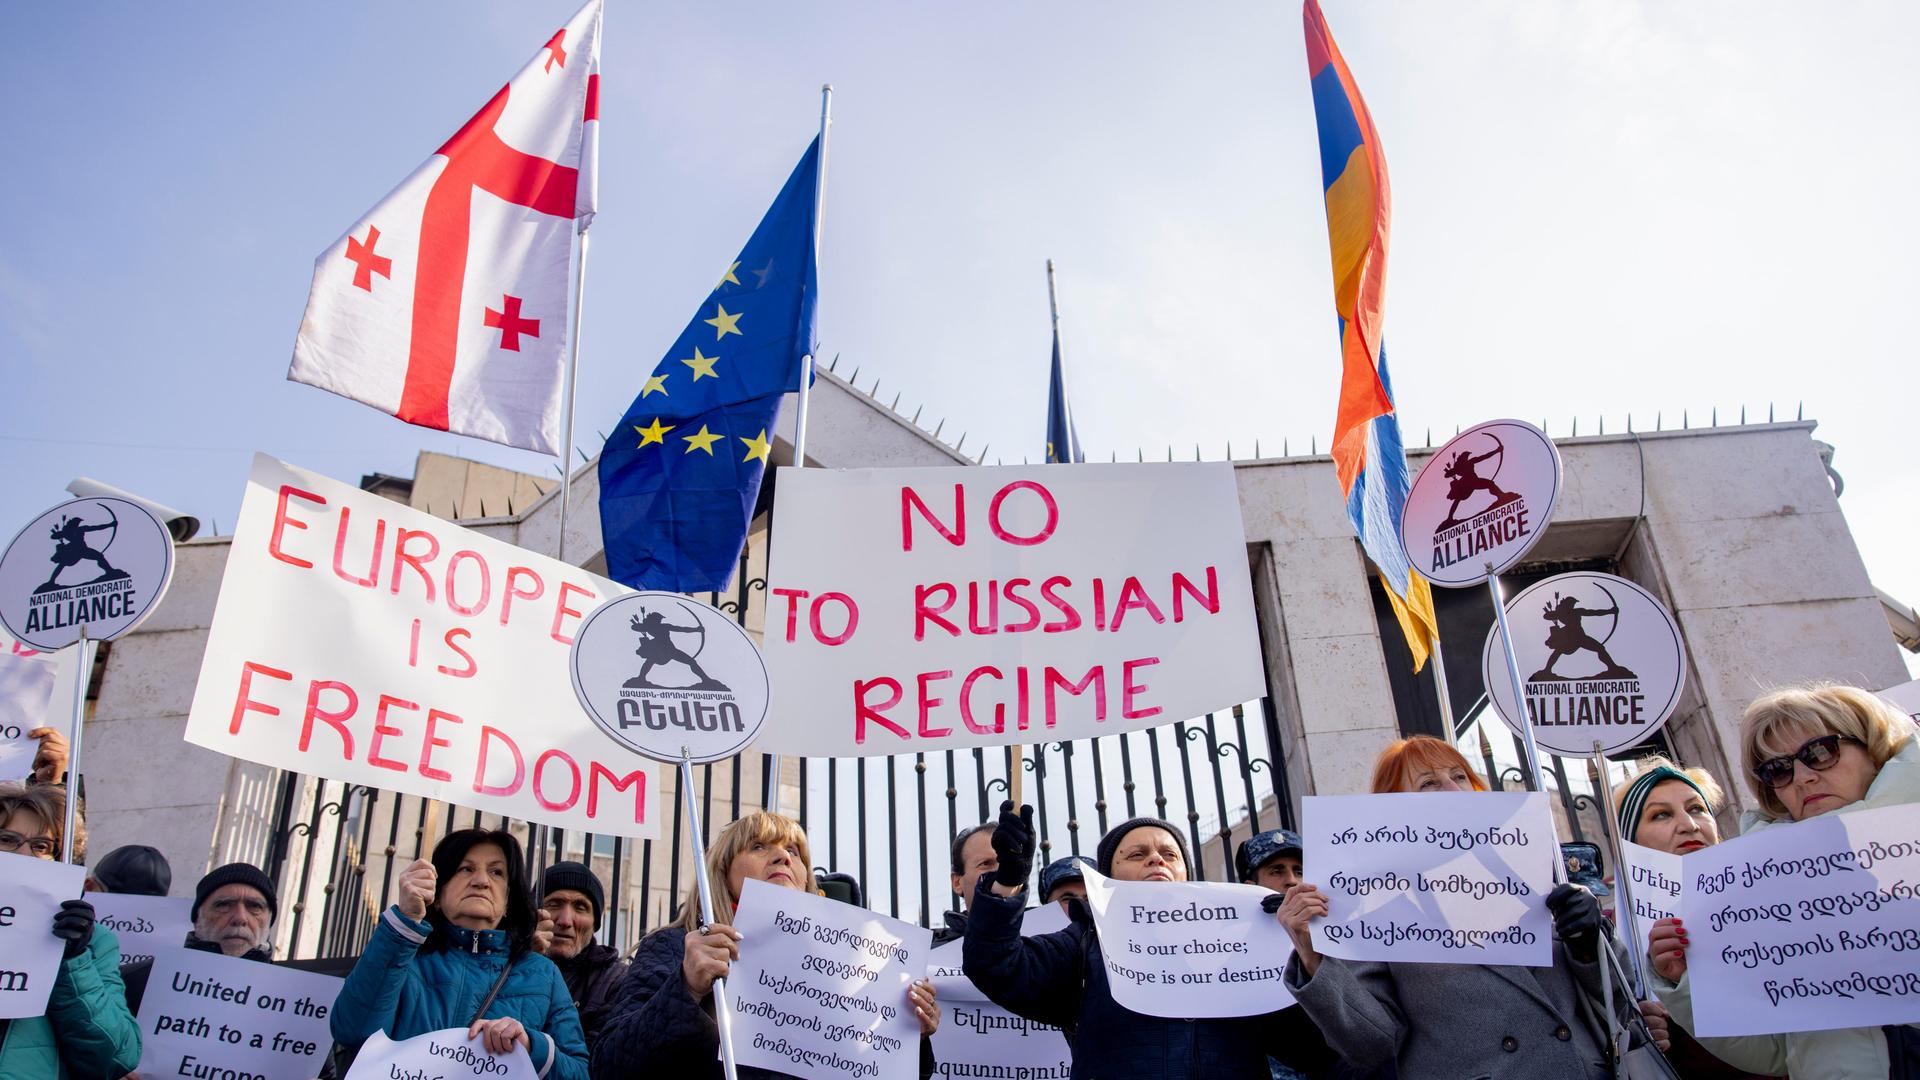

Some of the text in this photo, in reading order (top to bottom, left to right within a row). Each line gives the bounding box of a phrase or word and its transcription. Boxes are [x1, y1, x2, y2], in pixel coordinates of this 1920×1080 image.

[901, 480, 1059, 552] NO
[1433, 499, 1524, 546] NATIONAL DEMOCRATIC
[1431, 509, 1530, 572] ALLIANCE
[268, 485, 596, 646] EUROPE
[30, 579, 132, 607] NATIONAL DEMOCRATIC
[772, 566, 1220, 646] TO RUSSIAN
[25, 590, 136, 634] ALLIANCE
[408, 618, 478, 679] IS
[854, 657, 1163, 744] REGIME
[1526, 681, 1640, 695] NATIONAL DEMOCRATIC
[617, 699, 745, 732] ԲԵՎԵՌ
[1526, 695, 1645, 726] ALLIANCE
[228, 661, 646, 825] FREEDOM
[1331, 825, 1528, 850] არ არის პუტინის
[1330, 871, 1530, 900] რეჟიმი სომხეთსა
[1632, 865, 1681, 897] Մենք
[1697, 867, 1735, 894] ჩვენ
[1130, 902, 1239, 924] Freedom
[1710, 903, 1791, 932] ერთად
[774, 911, 908, 964] ჩვენ გვერდიგვერდ
[1128, 938, 1248, 955] is our choice;
[1324, 920, 1536, 949] და საქართველოში
[1722, 934, 1834, 968] რუსეთის
[802, 955, 878, 982] ვდგავართ
[1161, 970, 1175, 984] is
[1181, 972, 1213, 984] our
[1218, 966, 1285, 983] destiny
[172, 971, 327, 1019] United on the
[759, 969, 896, 1021] საქართველოსა და
[154, 1015, 317, 1055] path to a free
[736, 996, 901, 1053] სომხეთის ევროპული
[429, 1041, 508, 1076] სომხები
[753, 1033, 879, 1078] მომავლისთვის
